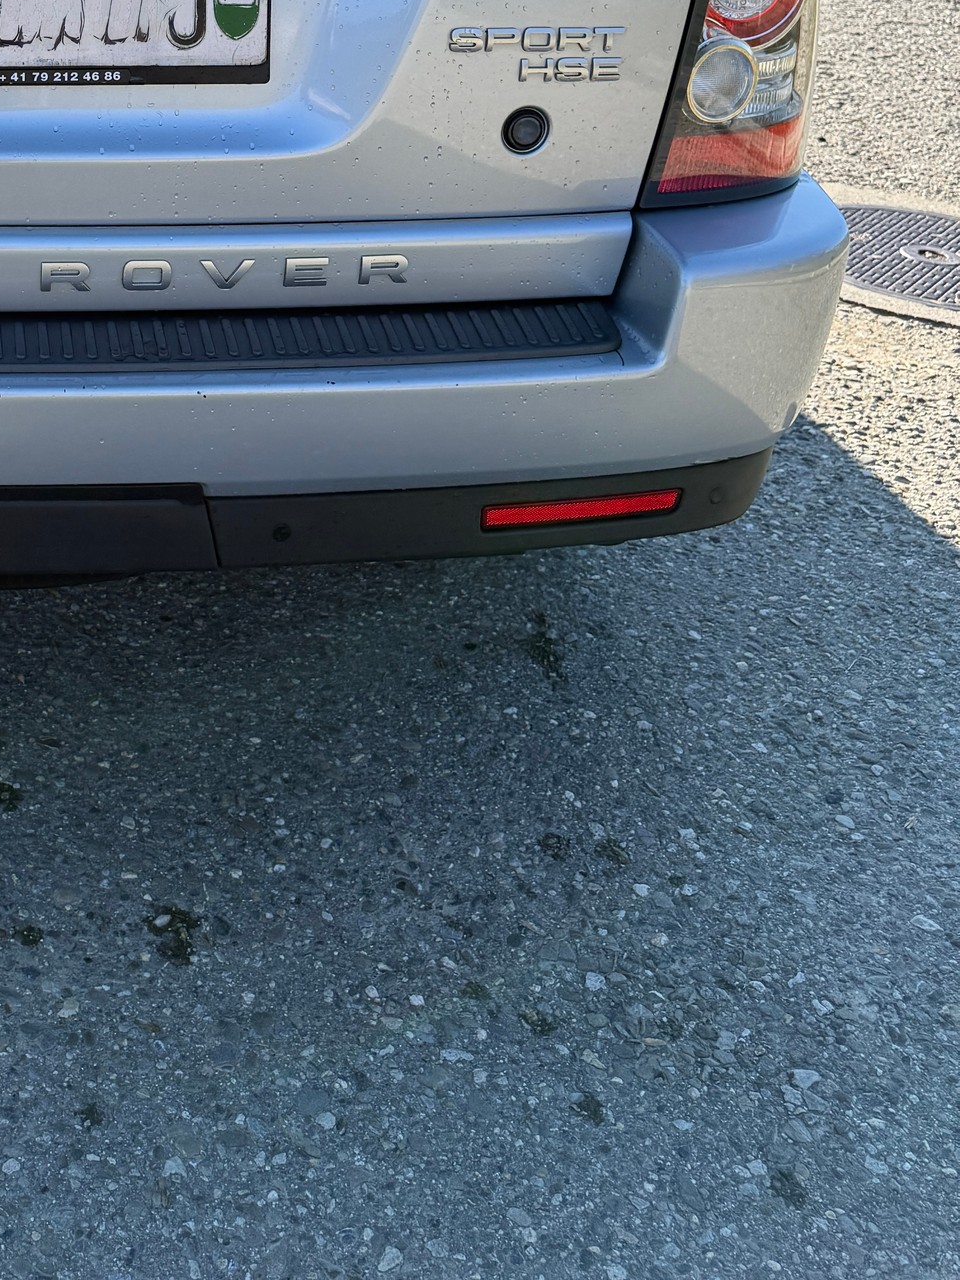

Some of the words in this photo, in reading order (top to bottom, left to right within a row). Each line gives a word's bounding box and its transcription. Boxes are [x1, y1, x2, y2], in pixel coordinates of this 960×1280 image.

[448, 26, 625, 53] SPORT
[32, 71, 49, 82] 79
[53, 71, 79, 81] 212
[82, 71, 100, 81] 46
[104, 70, 121, 81] 86
[518, 56, 624, 82] HSE
[40, 253, 409, 293] ROVER
